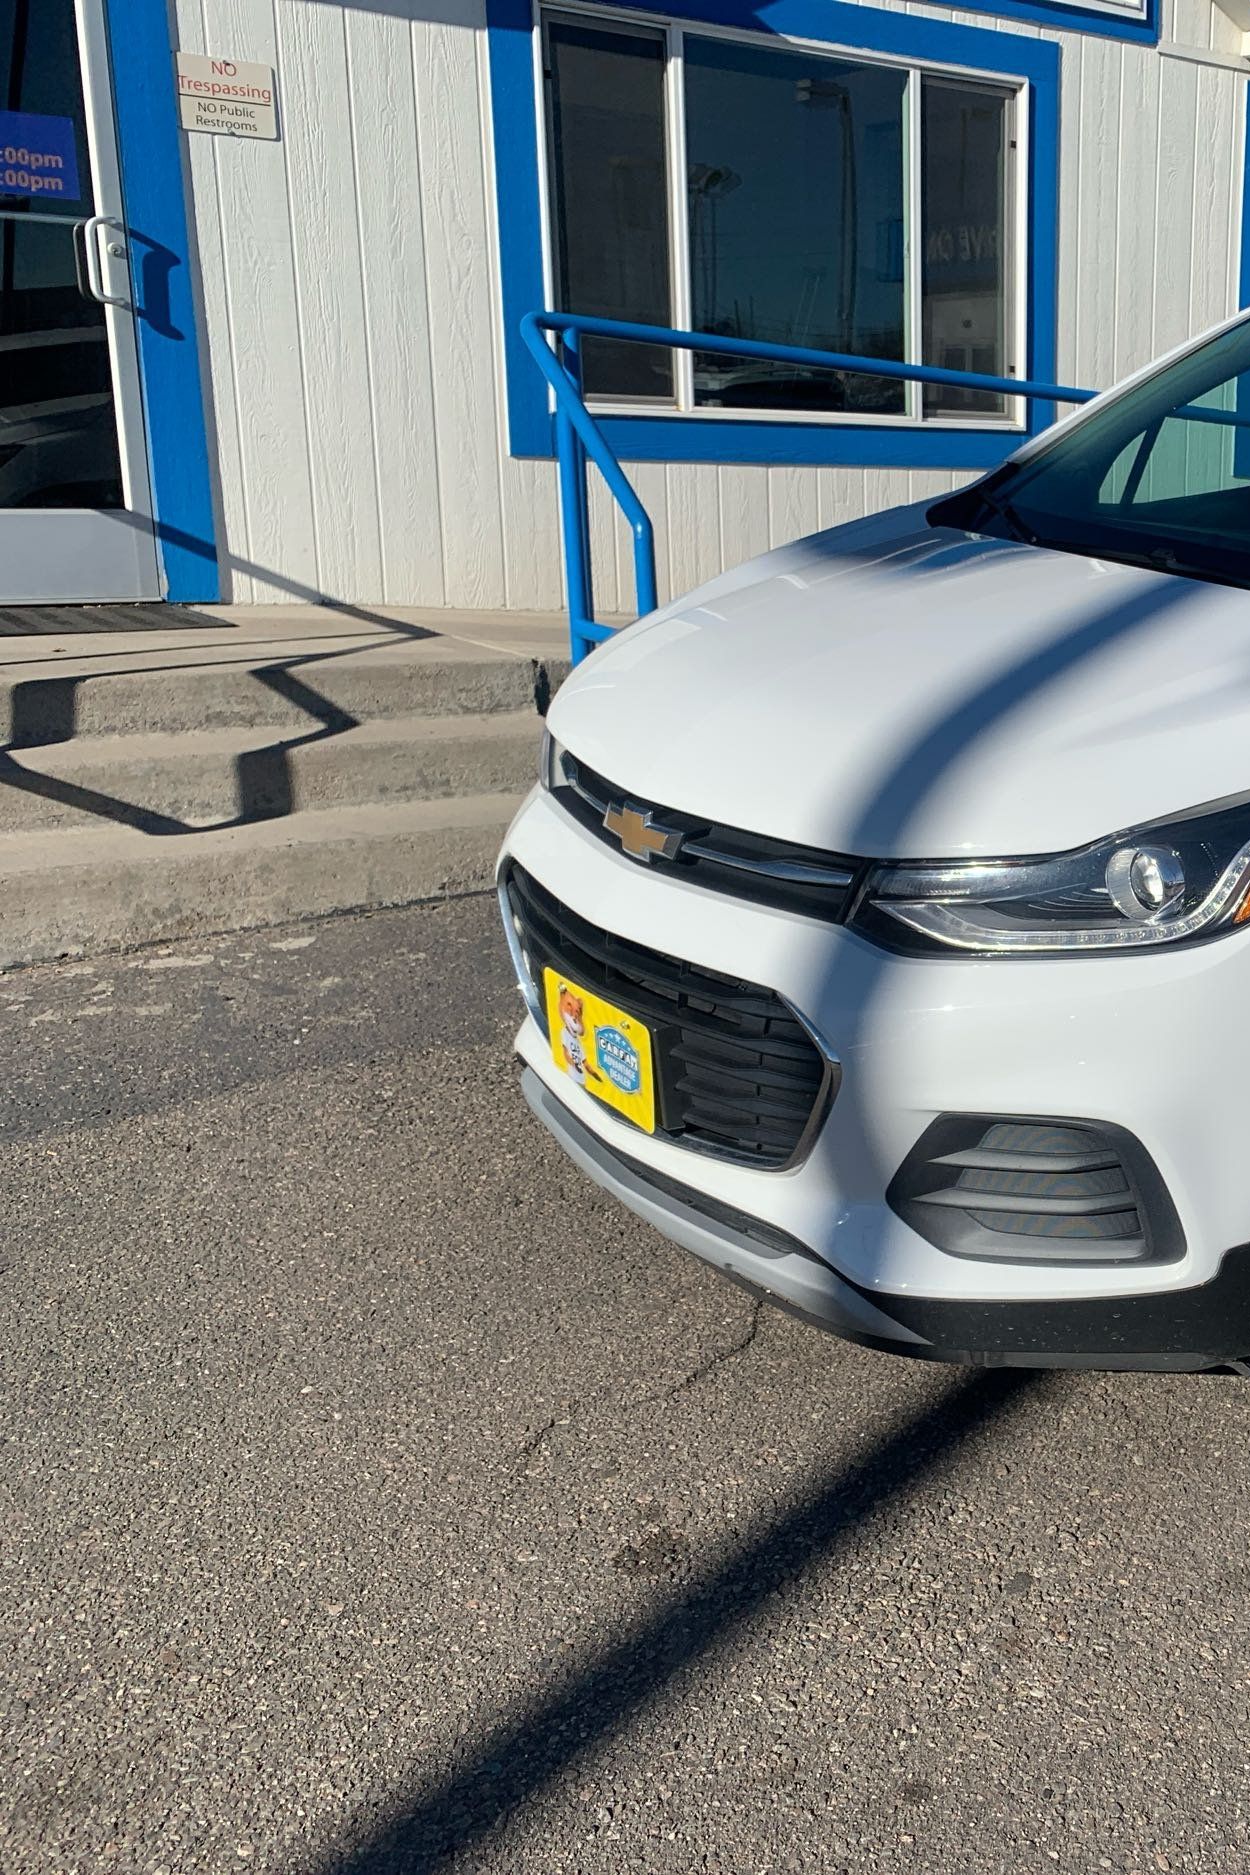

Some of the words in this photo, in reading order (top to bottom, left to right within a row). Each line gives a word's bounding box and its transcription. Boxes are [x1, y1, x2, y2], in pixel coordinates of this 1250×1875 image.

[211, 60, 237, 77] NO
[178, 75, 271, 103] Trespassing
[197, 102, 217, 114] NO
[220, 104, 256, 119] Public
[195, 114, 258, 132] Restrooms
[599, 1037, 638, 1071] CARFAX
